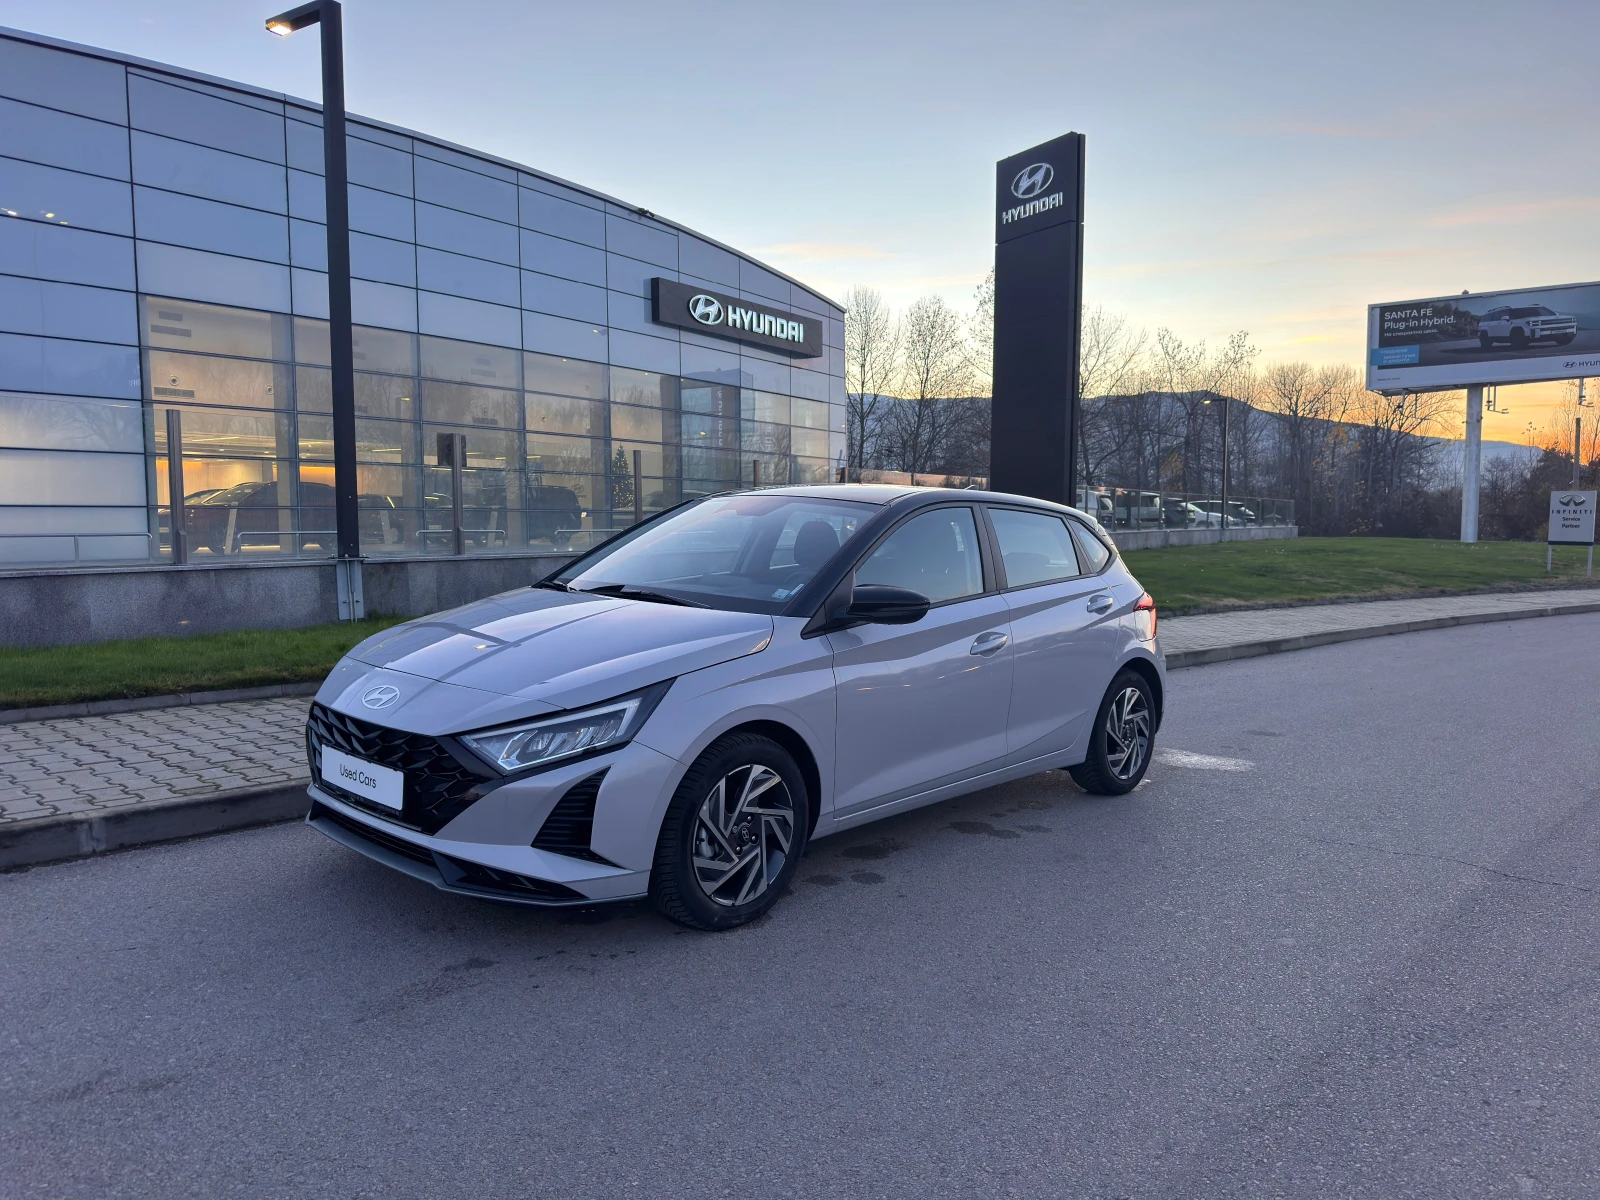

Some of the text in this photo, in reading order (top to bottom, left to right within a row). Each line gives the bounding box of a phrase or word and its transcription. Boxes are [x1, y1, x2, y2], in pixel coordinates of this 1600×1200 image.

[1002, 191, 1063, 224] HYUNDAI
[727, 305, 804, 343] HYUNDAI
[1384, 308, 1433, 320] SANTA FE
[1384, 315, 1457, 330] Plug-in Hybrid.
[339, 763, 377, 789] Used Cars
